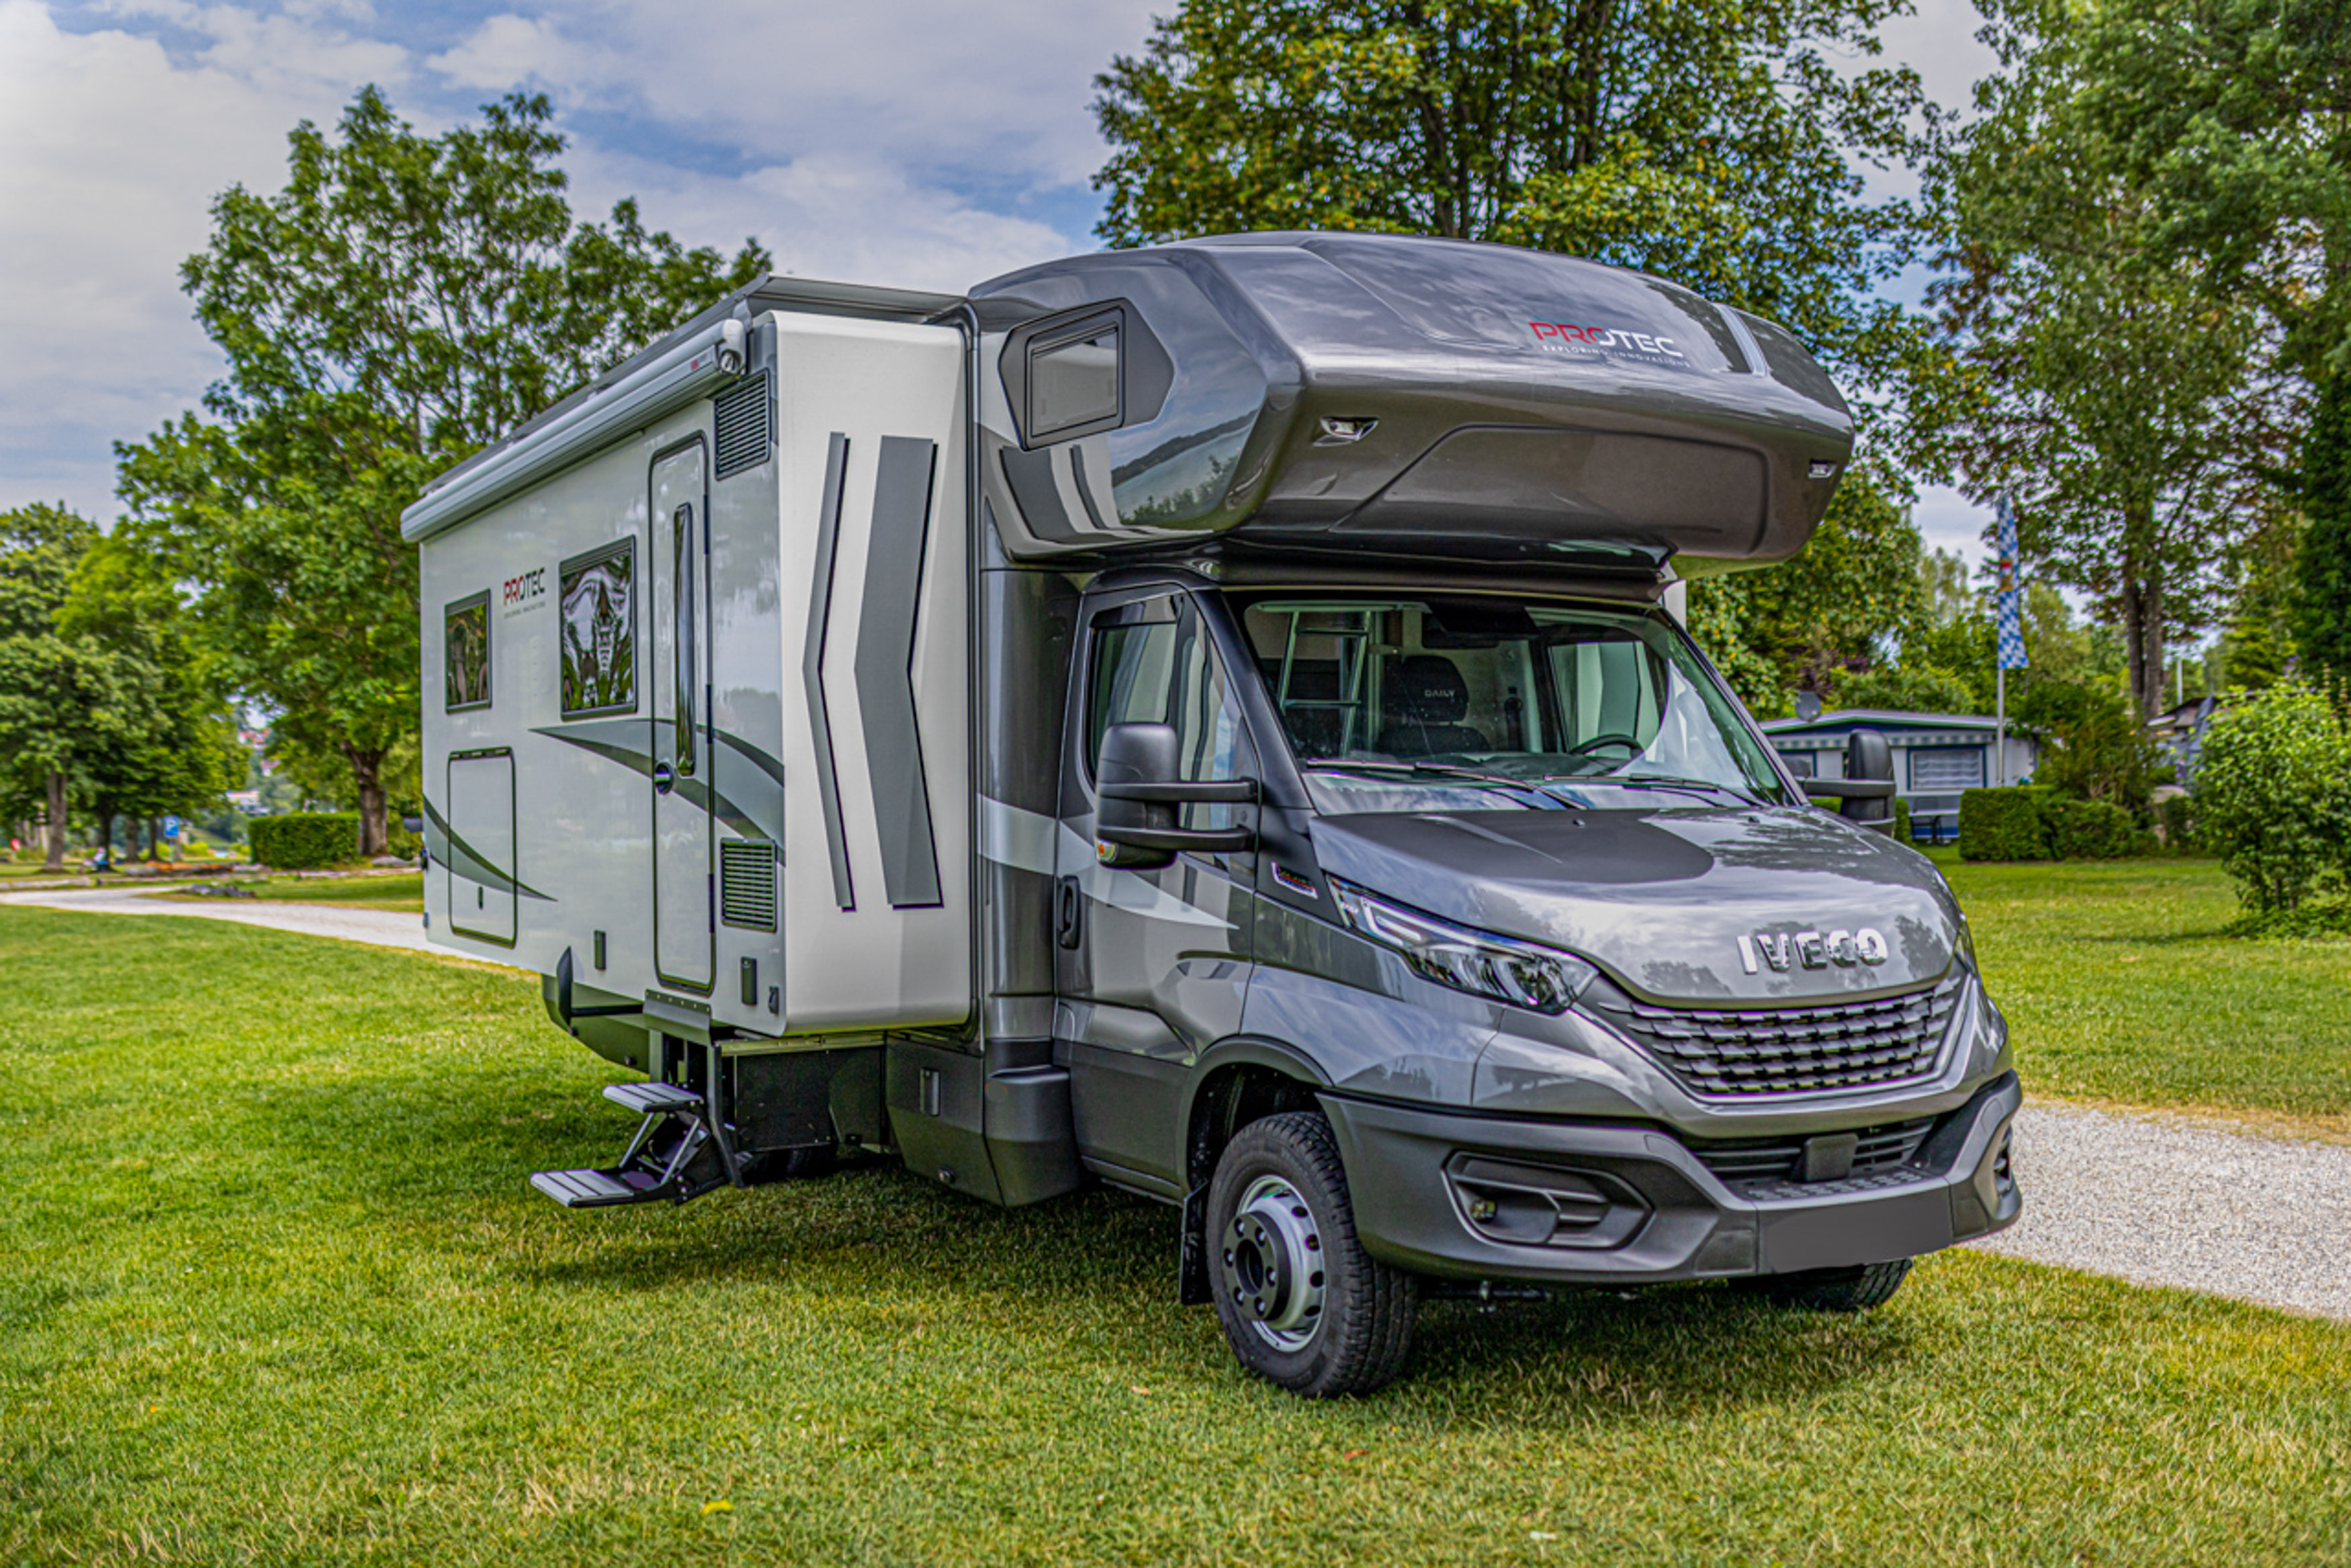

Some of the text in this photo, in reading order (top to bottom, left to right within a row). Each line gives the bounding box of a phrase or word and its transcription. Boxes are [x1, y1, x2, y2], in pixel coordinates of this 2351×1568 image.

[1528, 321, 1683, 357] PROTEC
[503, 567, 545, 607] PROTEC
[1425, 689, 1456, 698] DAILY
[1737, 928, 1888, 974] IVECO
